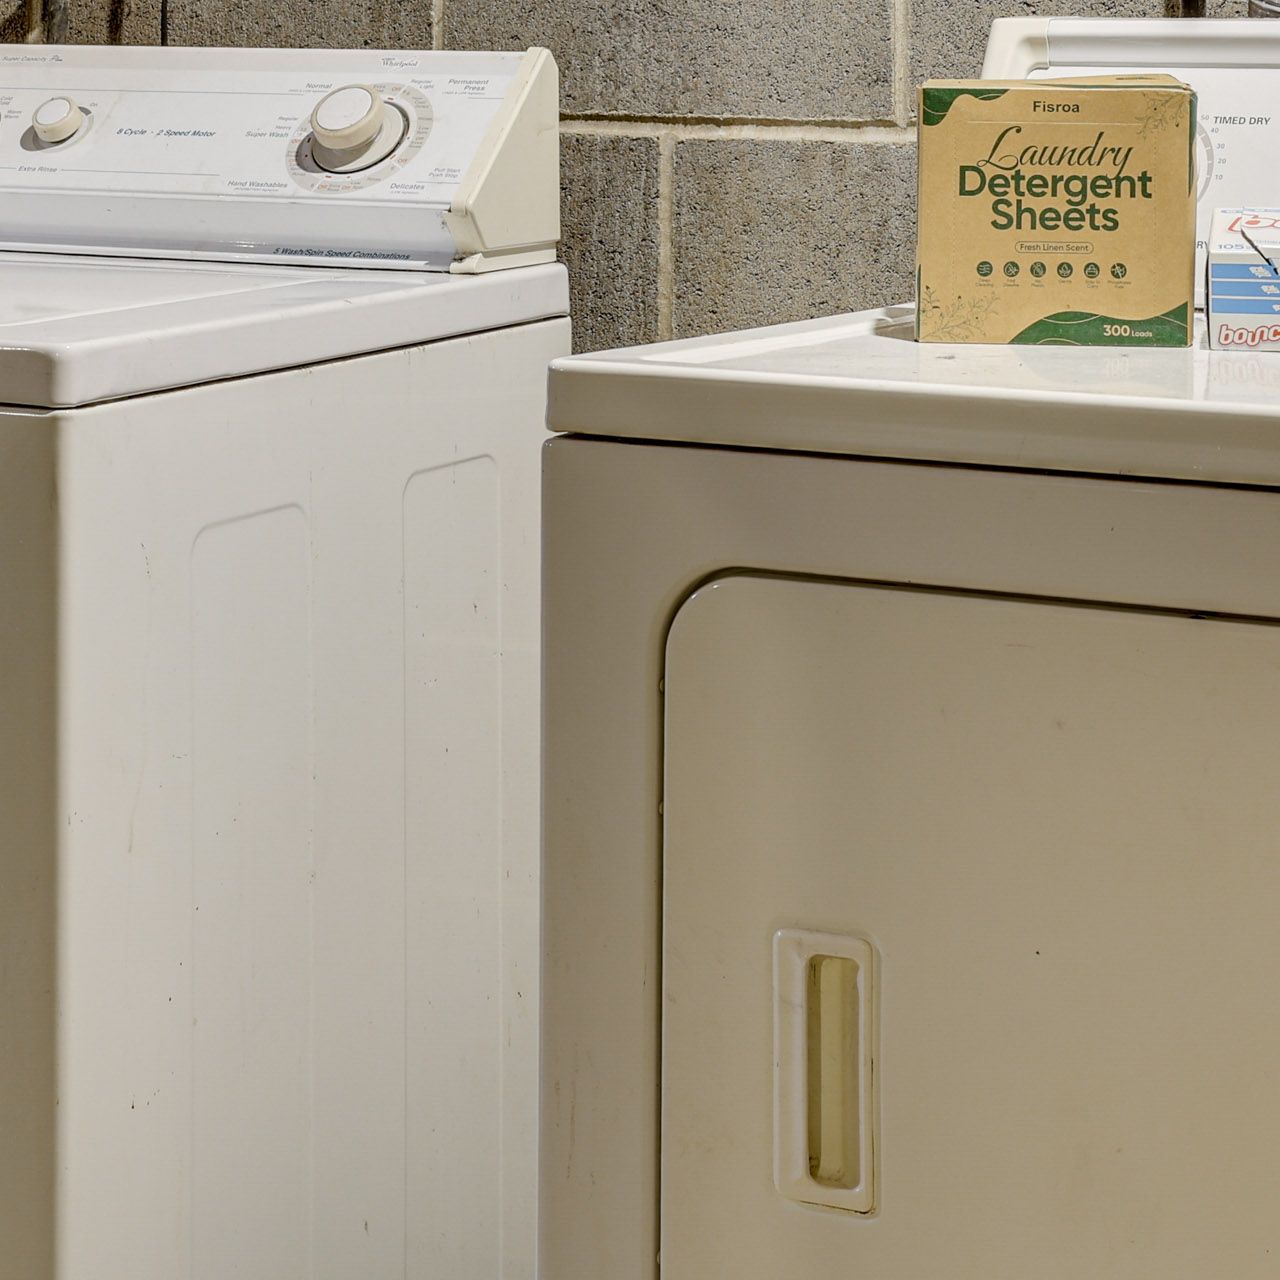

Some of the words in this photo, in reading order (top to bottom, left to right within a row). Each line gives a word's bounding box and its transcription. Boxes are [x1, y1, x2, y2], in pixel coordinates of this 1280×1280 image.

[1032, 100, 1080, 113] Fisroa
[1213, 116, 1246, 125] TIMED
[1249, 117, 1271, 125] DRY
[164, 129, 190, 138] Speed
[976, 125, 1134, 180] Laundry
[959, 165, 1152, 206] Detergent
[990, 198, 1119, 232] Sheets
[281, 248, 324, 256] Wash/Spin
[325, 250, 352, 258] Speed
[353, 251, 410, 260] Combinations
[1066, 244, 1089, 252] Scent
[1104, 325, 1130, 336] 300
